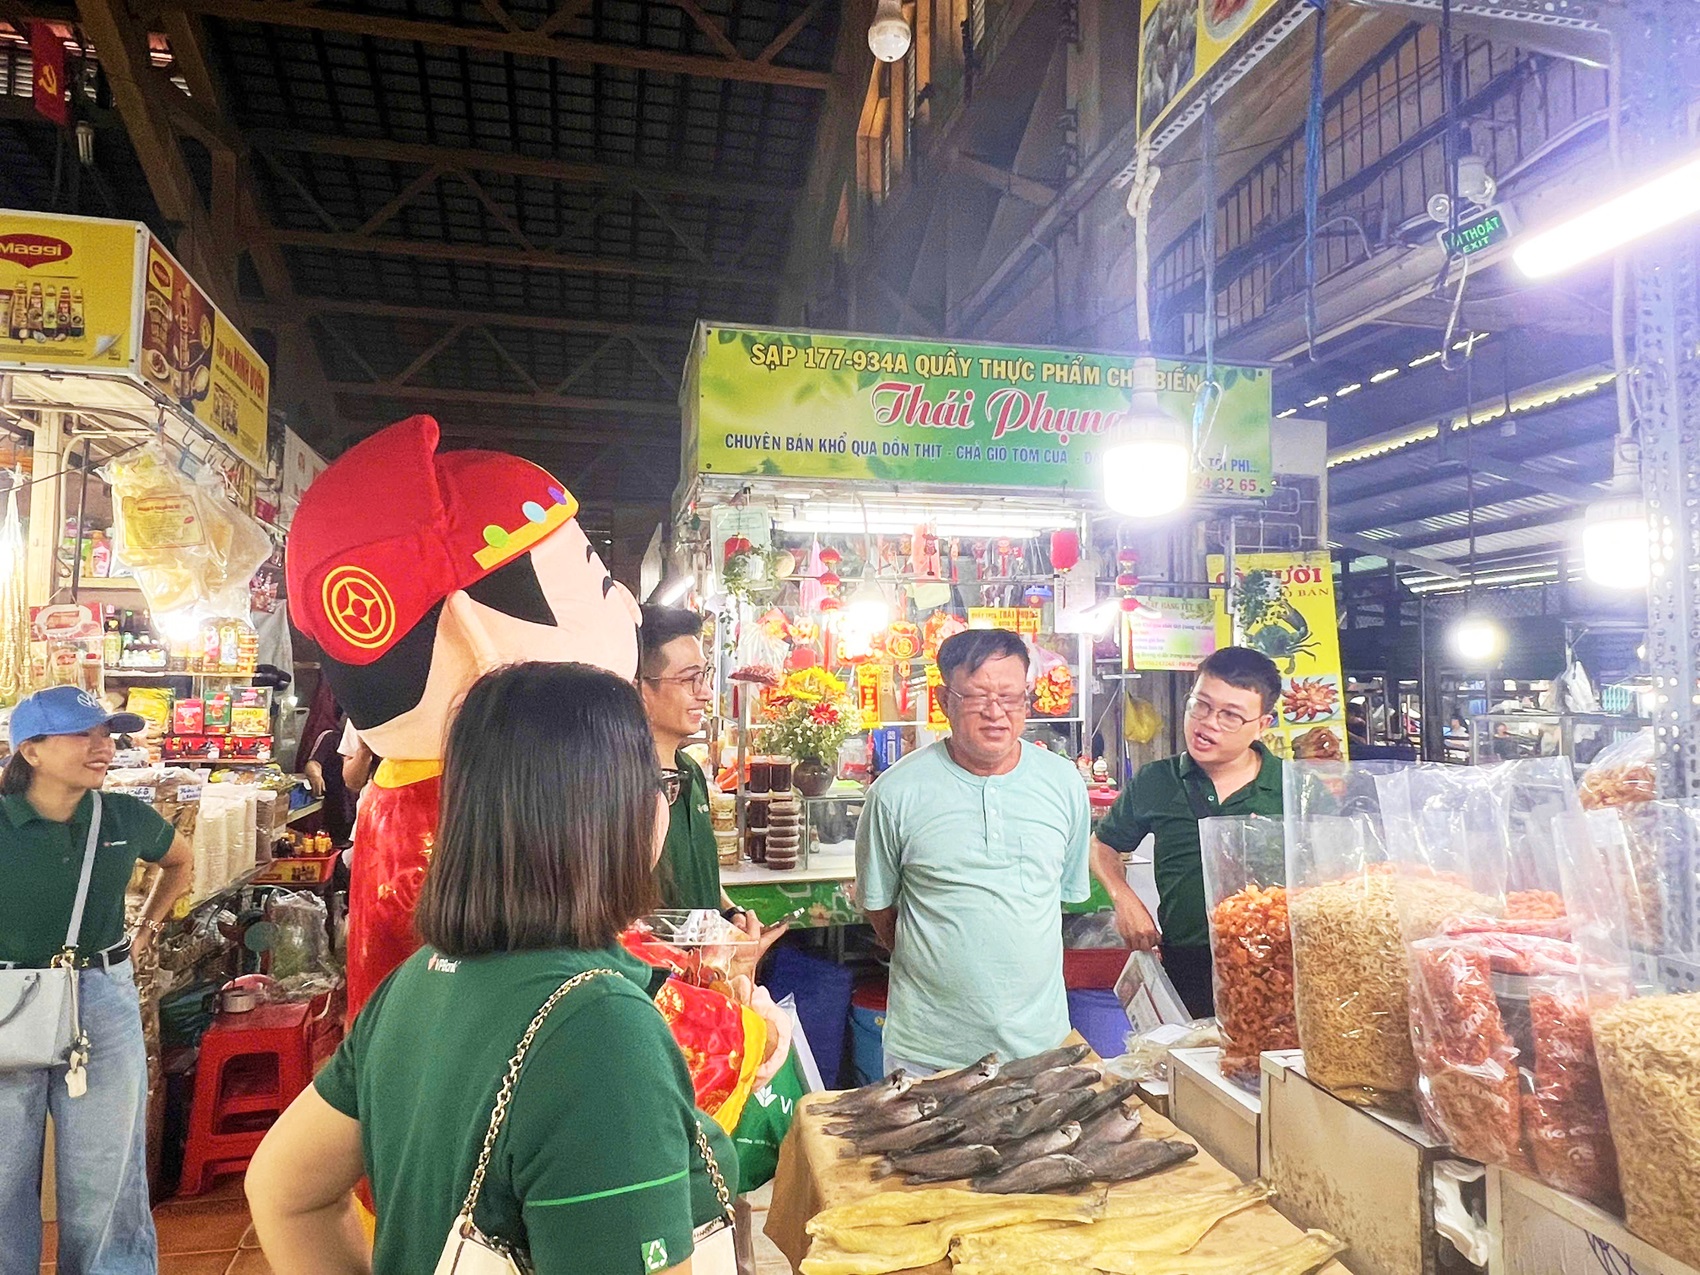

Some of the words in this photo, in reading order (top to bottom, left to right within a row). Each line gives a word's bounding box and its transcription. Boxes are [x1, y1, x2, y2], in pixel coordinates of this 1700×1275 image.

[1462, 217, 1500, 242] THOÁT
[1463, 236, 1489, 253] EXIT
[750, 343, 798, 371] SẠP
[804, 347, 909, 374] 177-934A
[914, 348, 973, 379] QUẦY
[978, 357, 1040, 385] THỰC
[1041, 355, 1101, 386] PHẨM
[1106, 367, 1140, 389] CH
[1155, 365, 1200, 393] BIẾN
[870, 381, 976, 430] Thái
[725, 431, 781, 450] CHUYÊN
[785, 432, 814, 452] BÁN
[819, 431, 848, 454] KHỔ
[851, 440, 877, 457] QUA
[914, 443, 943, 462] THỊT
[1044, 450, 1067, 464] CUA
[1240, 478, 1257, 492] 65
